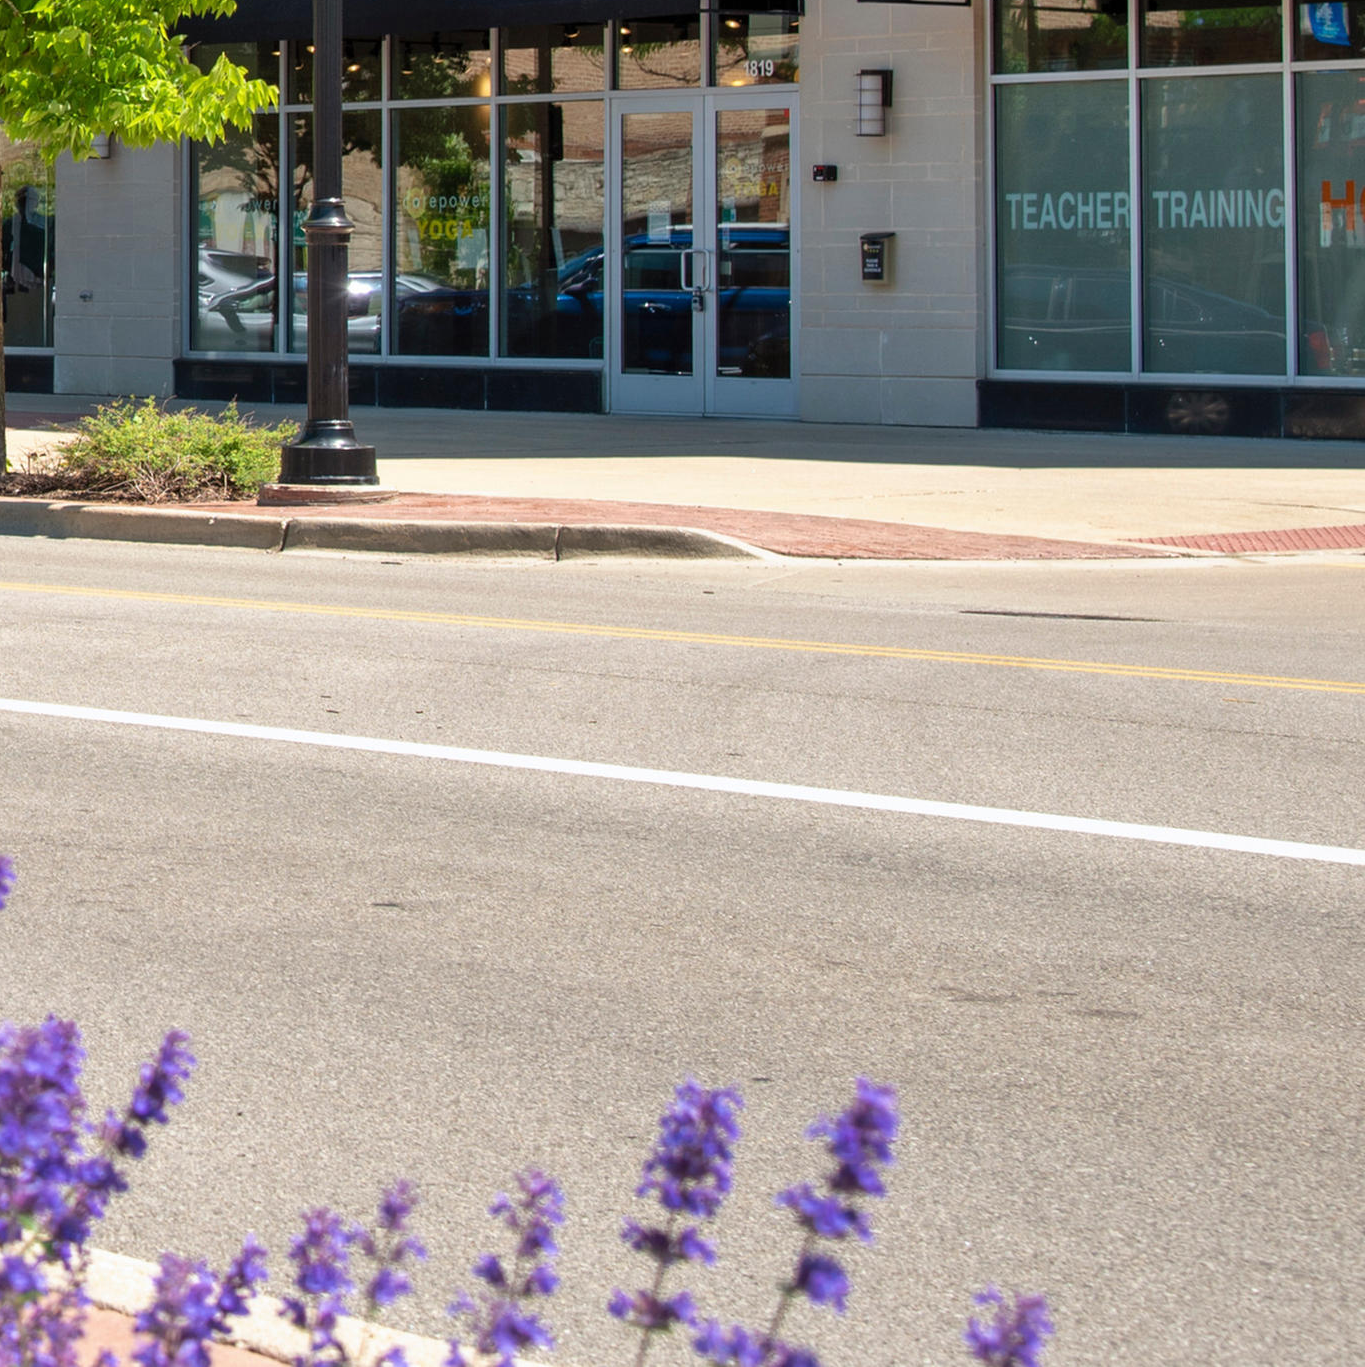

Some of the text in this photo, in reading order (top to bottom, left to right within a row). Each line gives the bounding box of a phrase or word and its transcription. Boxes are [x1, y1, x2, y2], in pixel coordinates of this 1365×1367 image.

[744, 59, 774, 77] 1819
[1006, 189, 1285, 230] TEACHER TRAINING
[1321, 179, 1365, 231] H
[416, 219, 473, 241] YOGA
